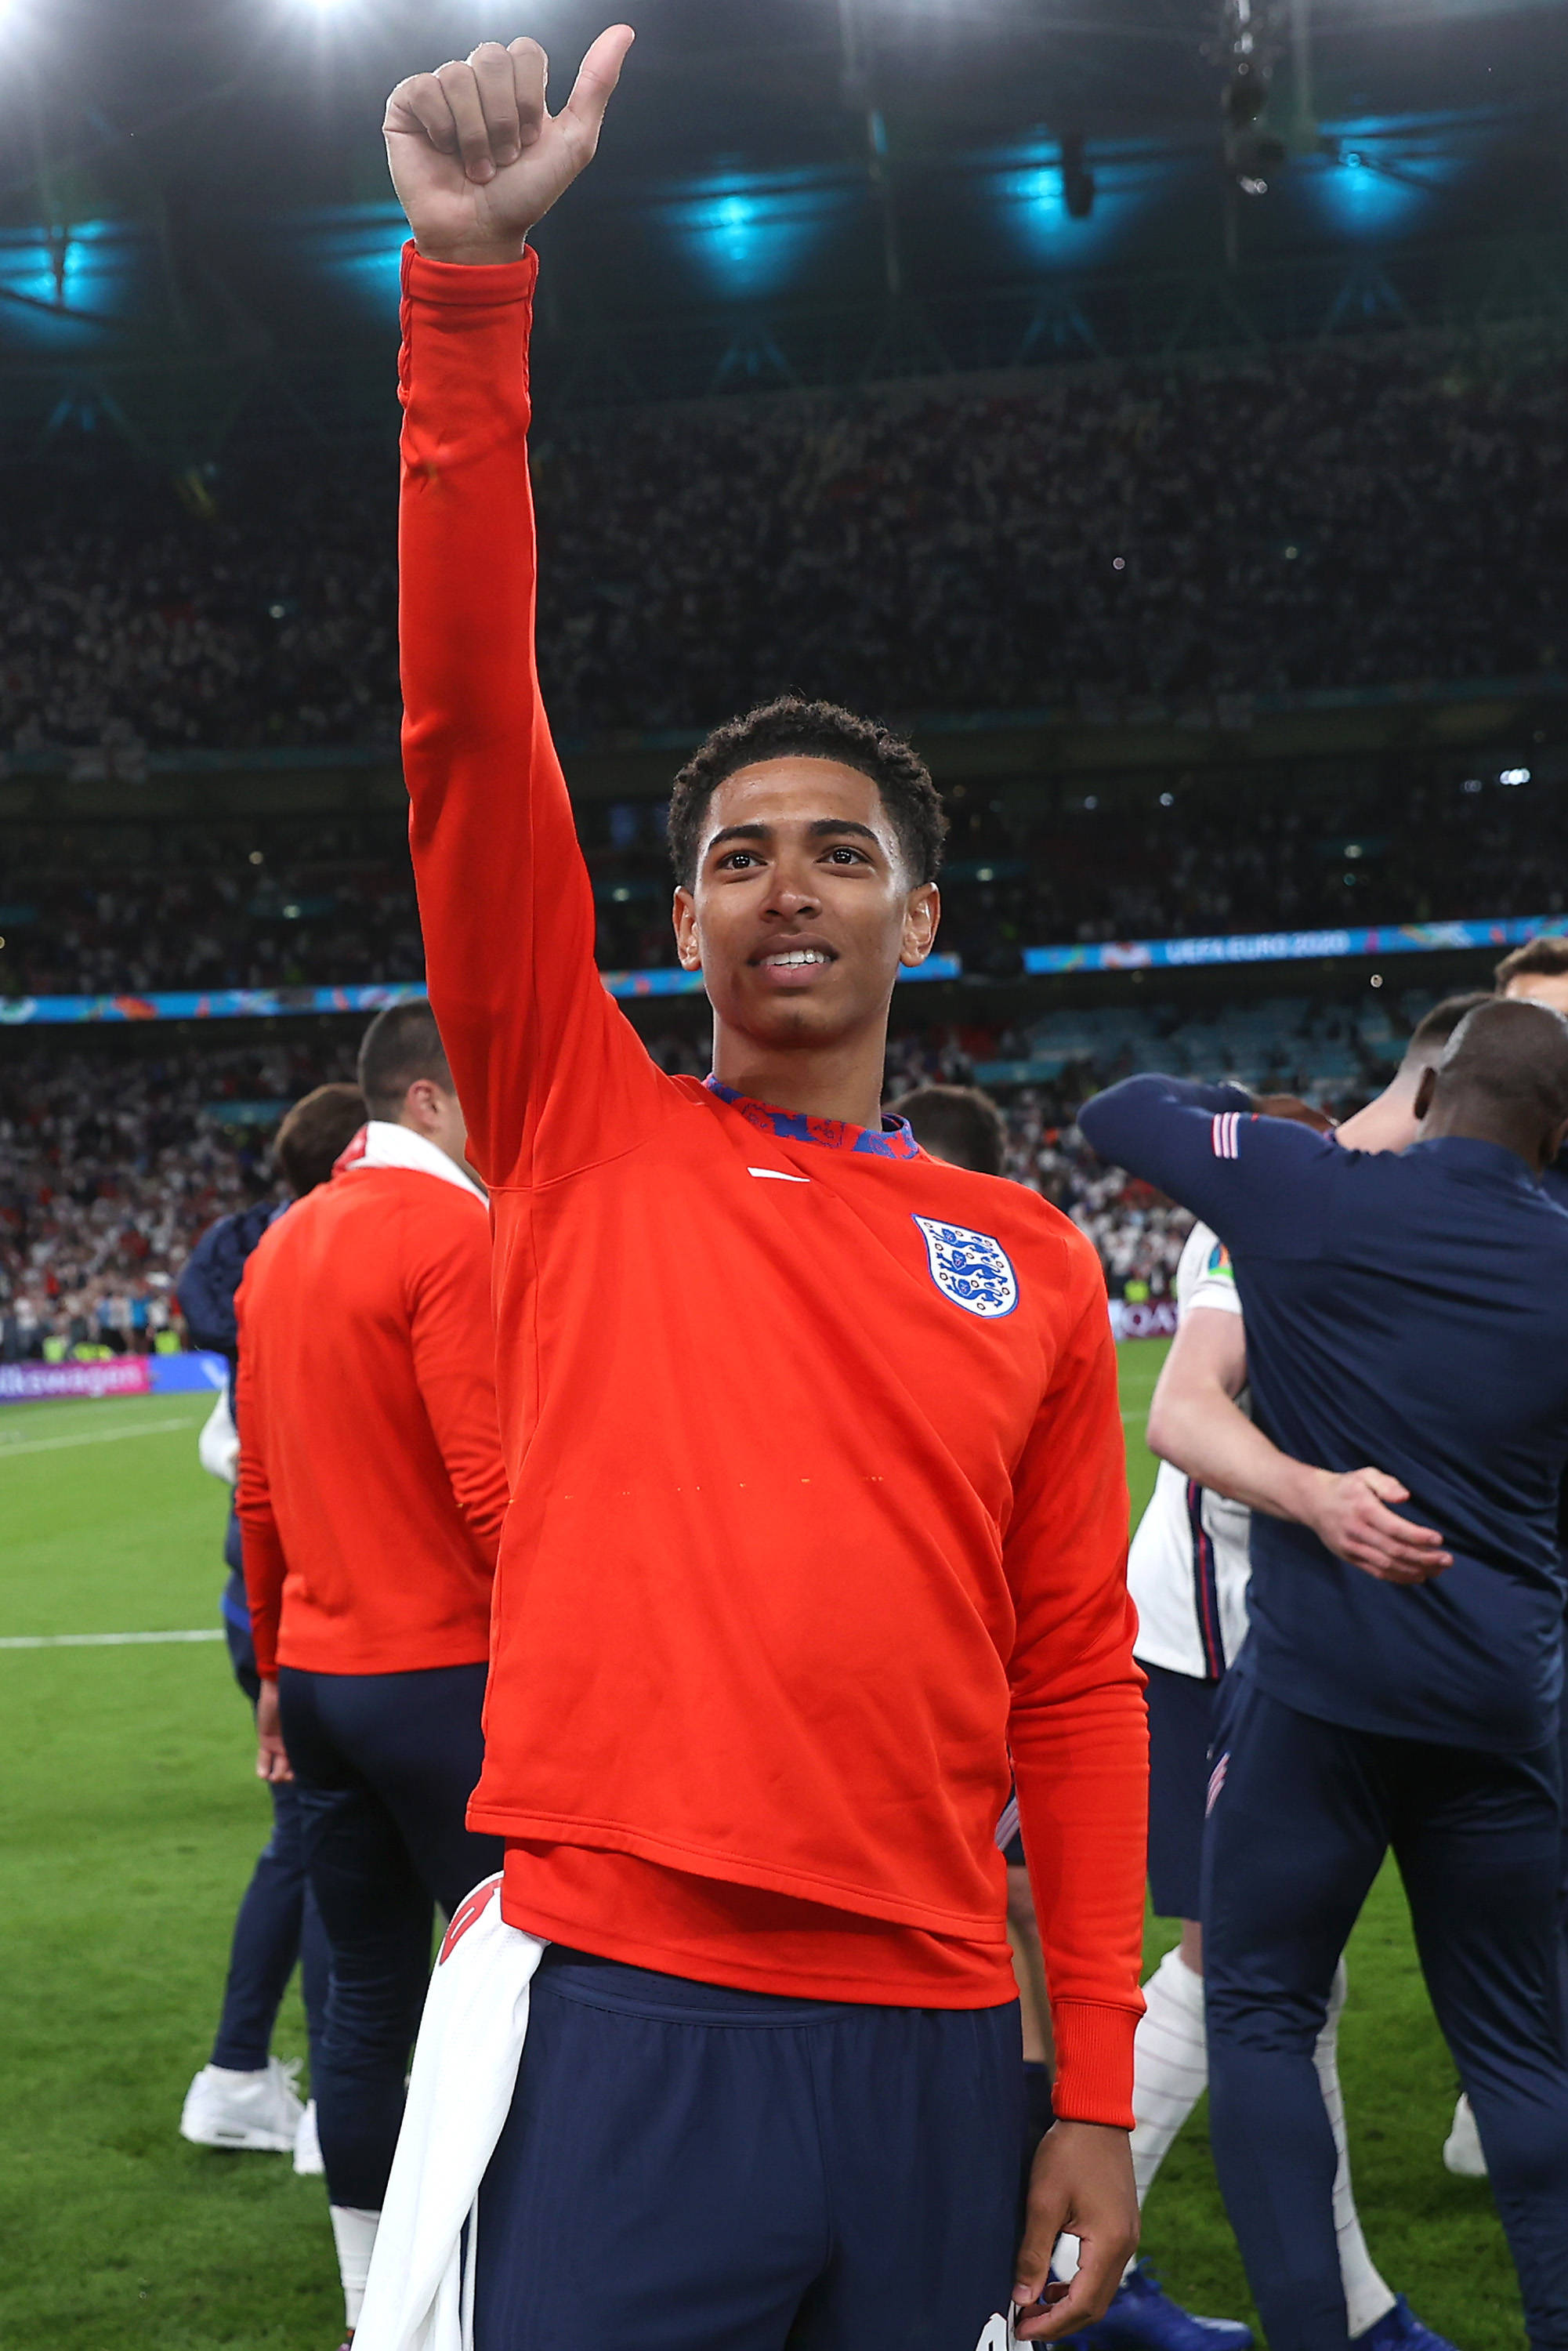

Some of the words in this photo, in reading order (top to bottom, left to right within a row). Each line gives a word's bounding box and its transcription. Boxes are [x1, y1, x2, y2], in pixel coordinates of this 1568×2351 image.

[1165, 939, 1224, 965] UEFA
[1227, 935, 1287, 961] EURO
[1292, 929, 1350, 957] 2020
